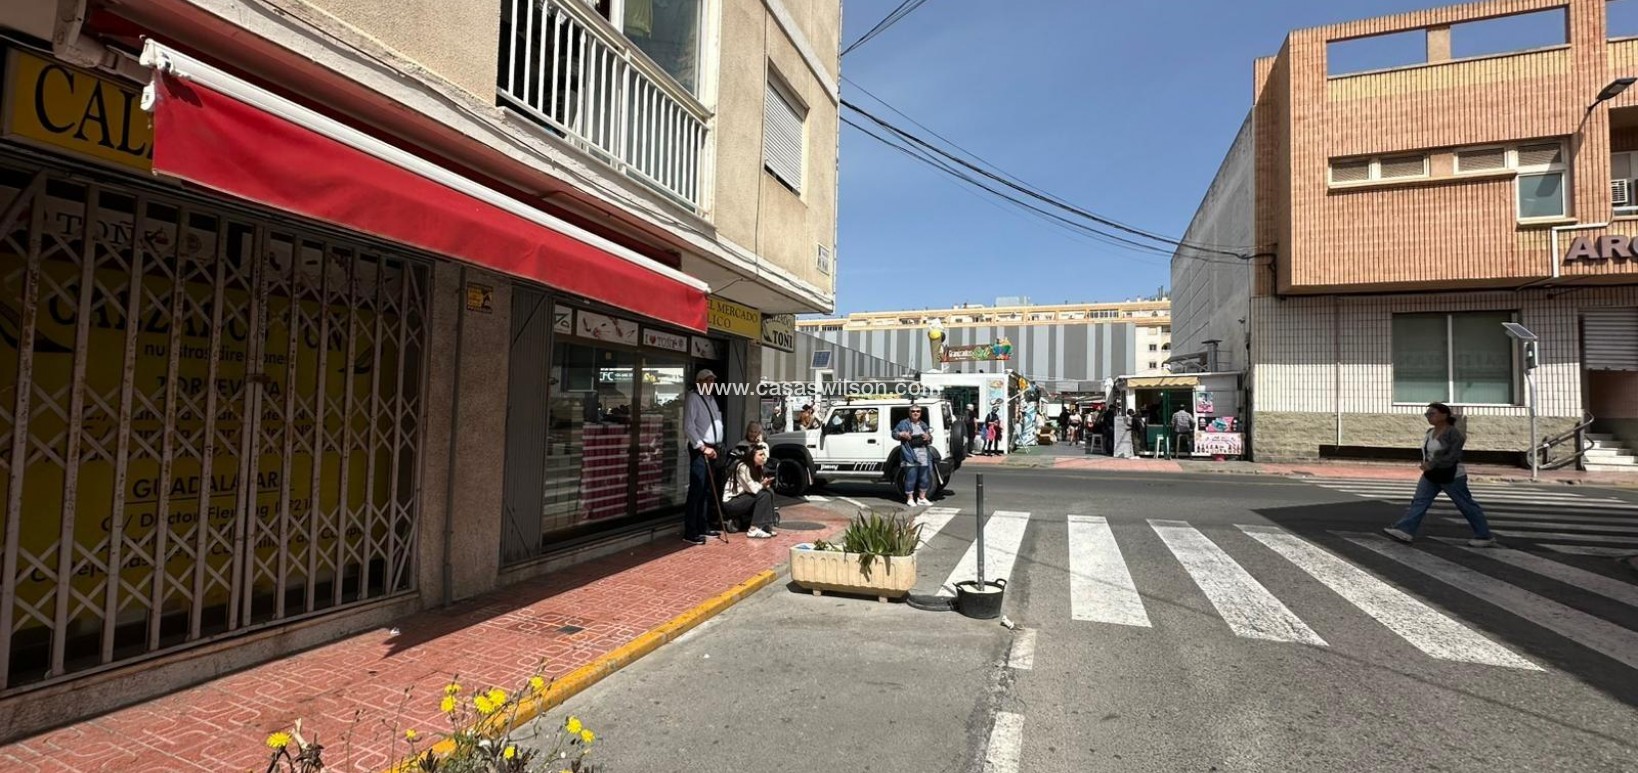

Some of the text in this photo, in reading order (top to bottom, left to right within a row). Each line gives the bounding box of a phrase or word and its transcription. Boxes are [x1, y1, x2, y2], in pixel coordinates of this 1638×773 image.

[34, 63, 154, 159] CAL
[1564, 235, 1638, 261] AR
[717, 302, 758, 323] MERCADO
[773, 329, 793, 348] TOÑI
